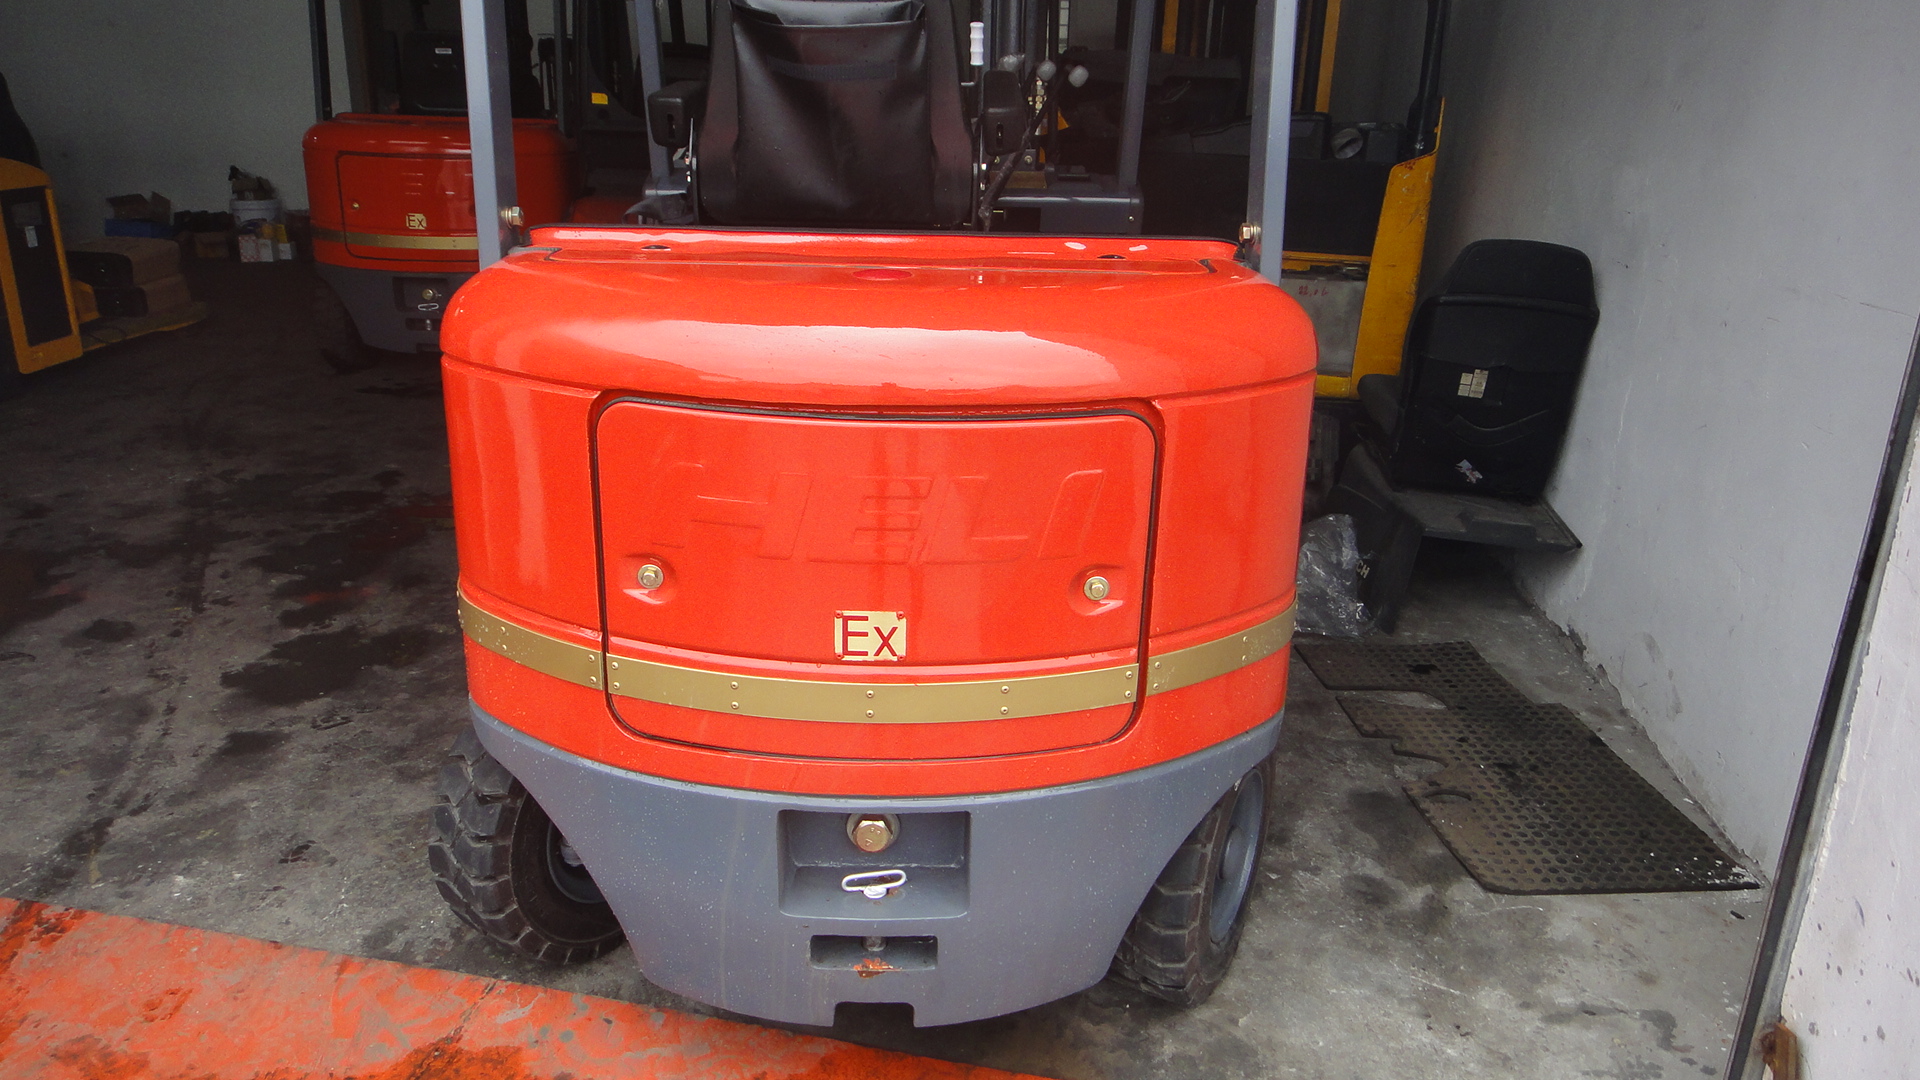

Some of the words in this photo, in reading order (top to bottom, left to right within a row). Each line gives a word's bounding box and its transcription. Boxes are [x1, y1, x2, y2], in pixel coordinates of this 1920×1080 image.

[408, 214, 425, 228] Ex
[1356, 559, 1370, 579] CH
[842, 615, 898, 657] Ex
